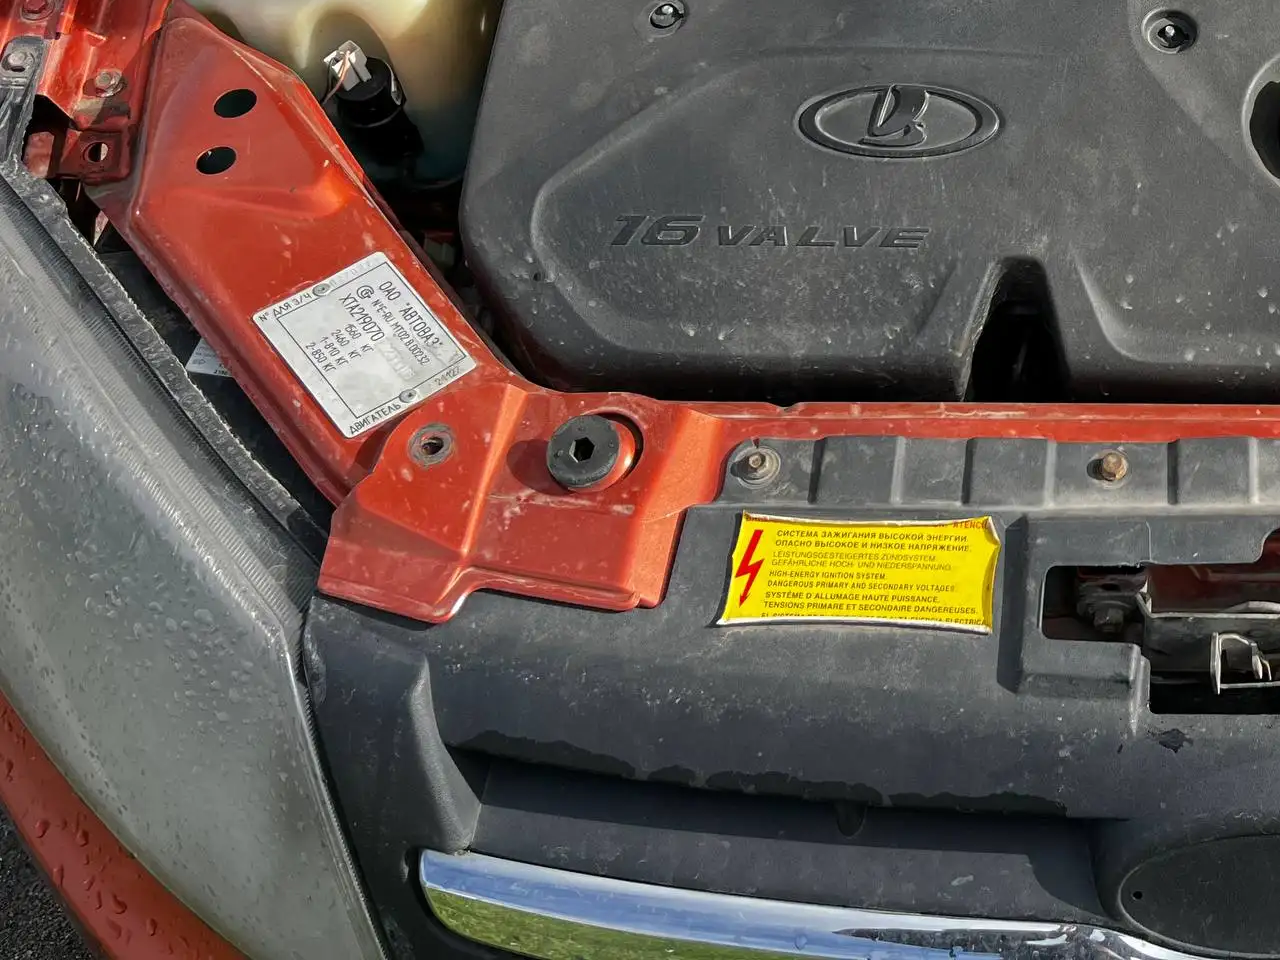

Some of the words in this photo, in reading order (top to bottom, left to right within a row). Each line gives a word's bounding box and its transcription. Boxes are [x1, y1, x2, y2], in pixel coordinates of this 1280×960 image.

[610, 214, 706, 247] 16
[717, 225, 932, 249] VALVE
[379, 281, 401, 301] ОАО
[273, 302, 292, 317] ДЛЯ
[339, 293, 385, 341] XTA219070
[331, 329, 350, 346] 2460
[345, 323, 362, 340] 1560
[305, 342, 328, 364] 2-850
[320, 336, 341, 356] 1-810
[349, 403, 402, 435] ДВИГАТЕЛЬ
[777, 530, 818, 538] СИСТЕМА
[821, 531, 877, 539] ЗАЖИГАНИЯ
[879, 532, 924, 541] ВЫСОКОЙ
[775, 539, 812, 547] ОПАСНО
[870, 542, 905, 550] НИЗКОЕ
[858, 561, 876, 569] UND
[769, 570, 820, 579] HIGH-ENERGY
[767, 580, 814, 588] DANGEROUS
[816, 581, 849, 589] PRIMARY
[850, 582, 866, 590] AND
[868, 582, 914, 591] SECONDARY
[862, 594, 889, 602] HAUTE
[763, 601, 805, 609] TENSIONS
[846, 603, 857, 611] ET
[858, 604, 912, 612] SECONDAIRE
